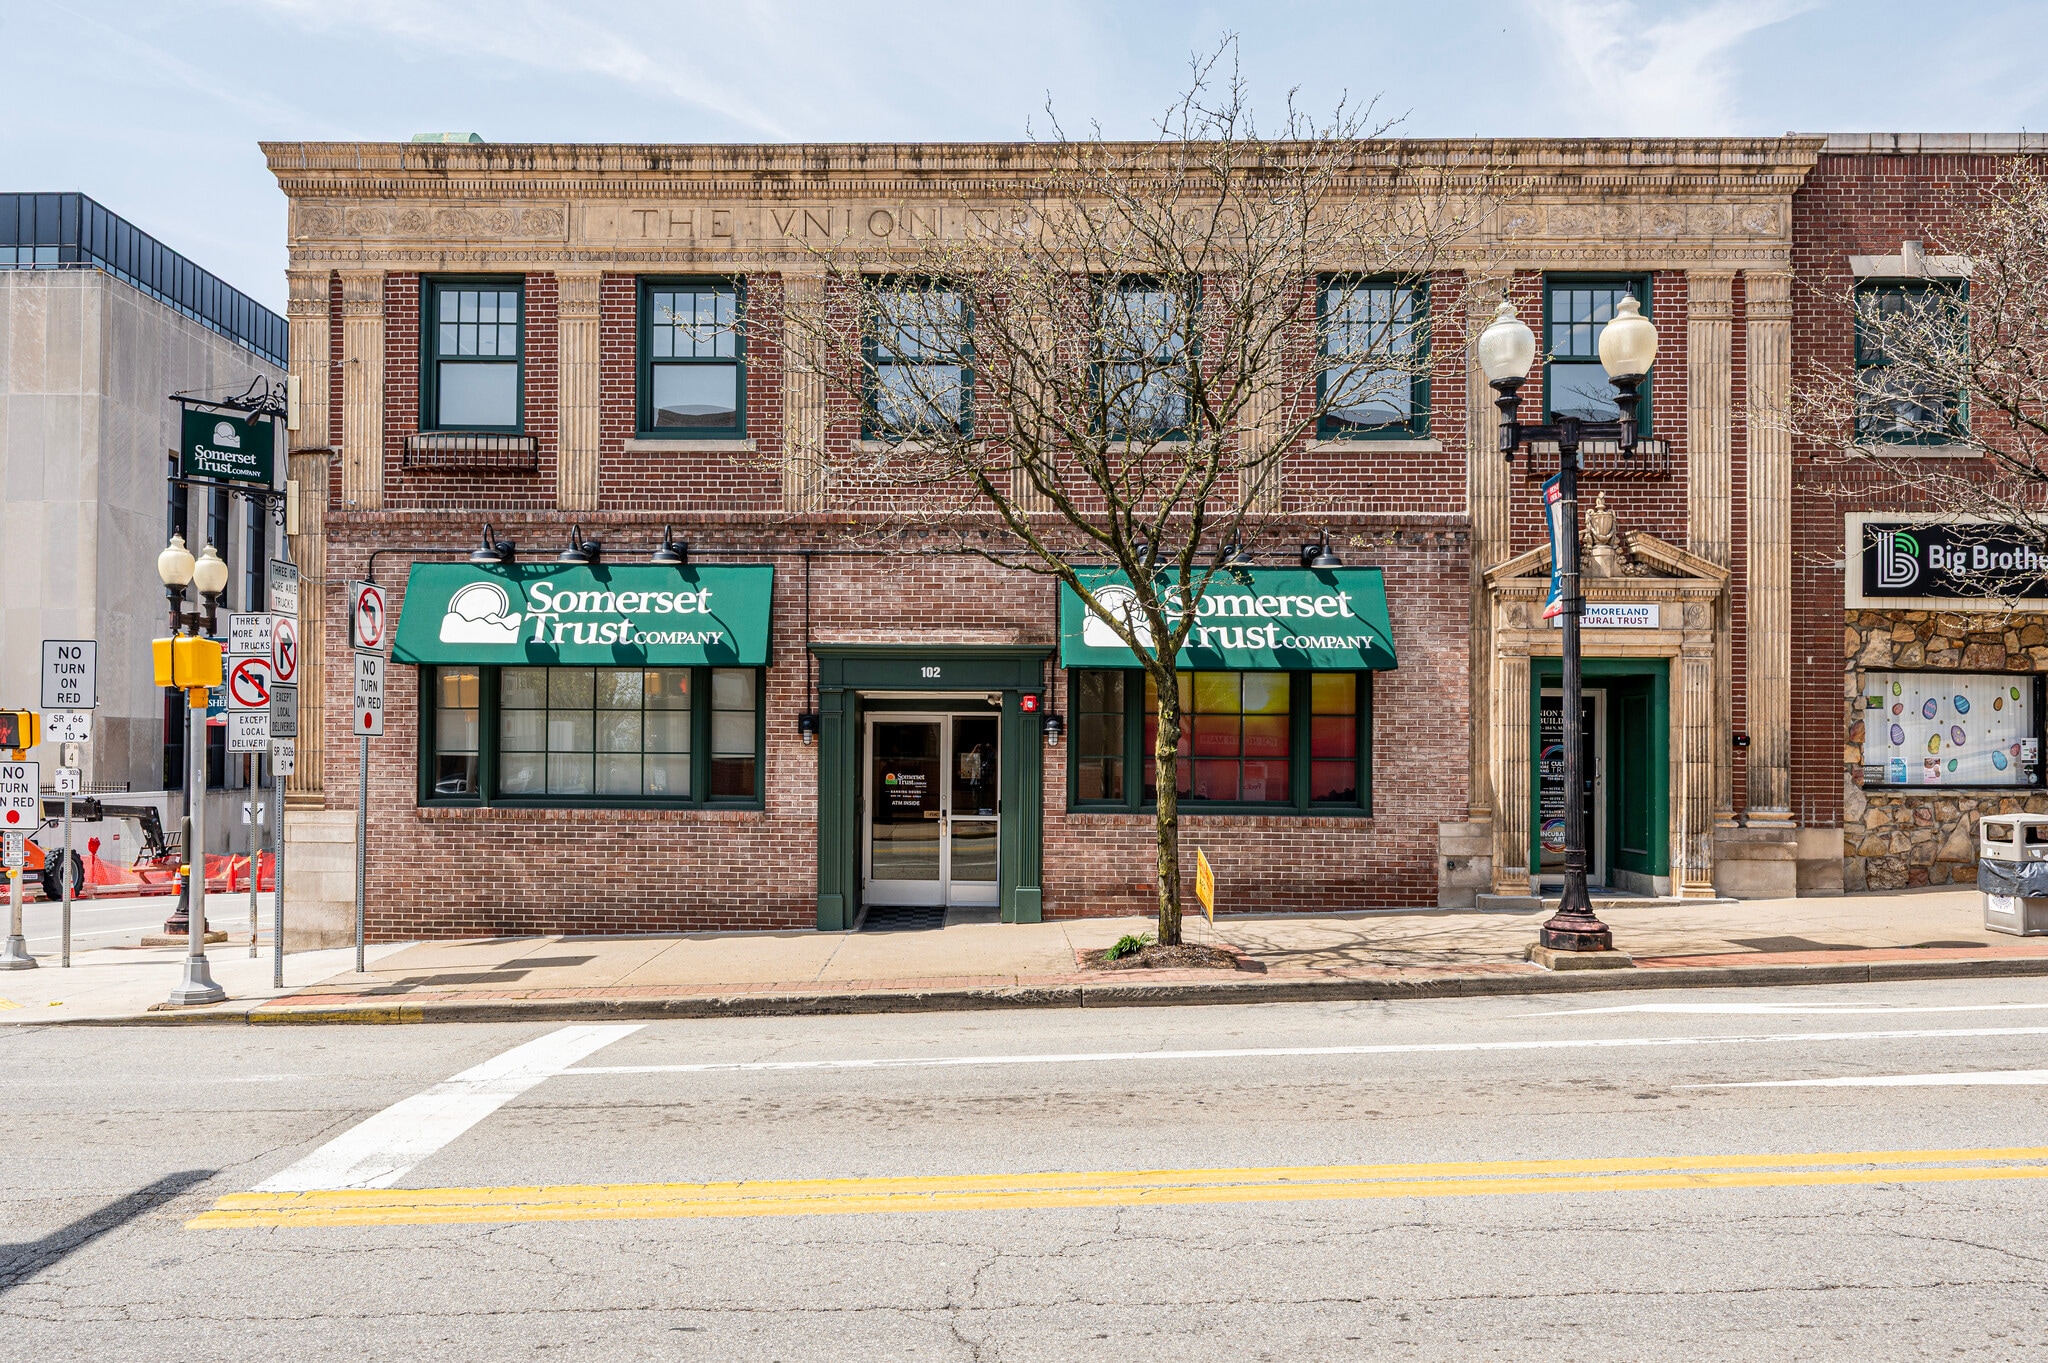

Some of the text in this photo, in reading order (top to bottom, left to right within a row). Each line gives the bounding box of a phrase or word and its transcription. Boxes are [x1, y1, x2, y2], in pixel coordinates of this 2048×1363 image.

[631, 209, 732, 238] THE
[194, 444, 257, 465] Somerset
[194, 456, 261, 477] Trust COMPANY
[1929, 545, 2048, 576] Big Brothe
[272, 564, 297, 579] THREE OR
[285, 584, 297, 595] AXLE
[275, 596, 294, 610] TRUCKS
[527, 581, 713, 614] Somerset
[1164, 584, 1356, 617] Somerset
[1586, 607, 1649, 616] TMORELAND
[235, 617, 260, 625] THREE
[1617, 616, 1649, 625] TRUST
[232, 629, 271, 638] MORE AX
[524, 611, 724, 645] Trust COMPANY
[240, 641, 271, 650] TRUCKS
[1283, 635, 1373, 650] COMPANY
[58, 646, 82, 660] NO
[53, 663, 85, 674] TURN
[362, 659, 376, 676] NO
[920, 666, 941, 678] 102
[61, 678, 77, 689] ON
[360, 679, 378, 692] TURN
[57, 692, 81, 704] RED
[276, 692, 292, 703] EXCEPT
[356, 695, 381, 709] ON RED
[277, 706, 291, 717] LOCAL
[53, 714, 84, 723] SR 66
[239, 715, 268, 724] EXCEPT
[66, 723, 72, 732] 4
[241, 727, 266, 736] LOCAL
[272, 721, 295, 732] DELIVERIES
[65, 732, 75, 741] 10
[273, 746, 294, 757] SR 3026
[69, 752, 74, 763] 4
[280, 760, 287, 772] 51
[3, 766, 25, 780] NO
[897, 773, 926, 781] Somerset
[0, 782, 29, 794] TURN
[61, 779, 74, 790] 51
[13, 796, 35, 808] RED
